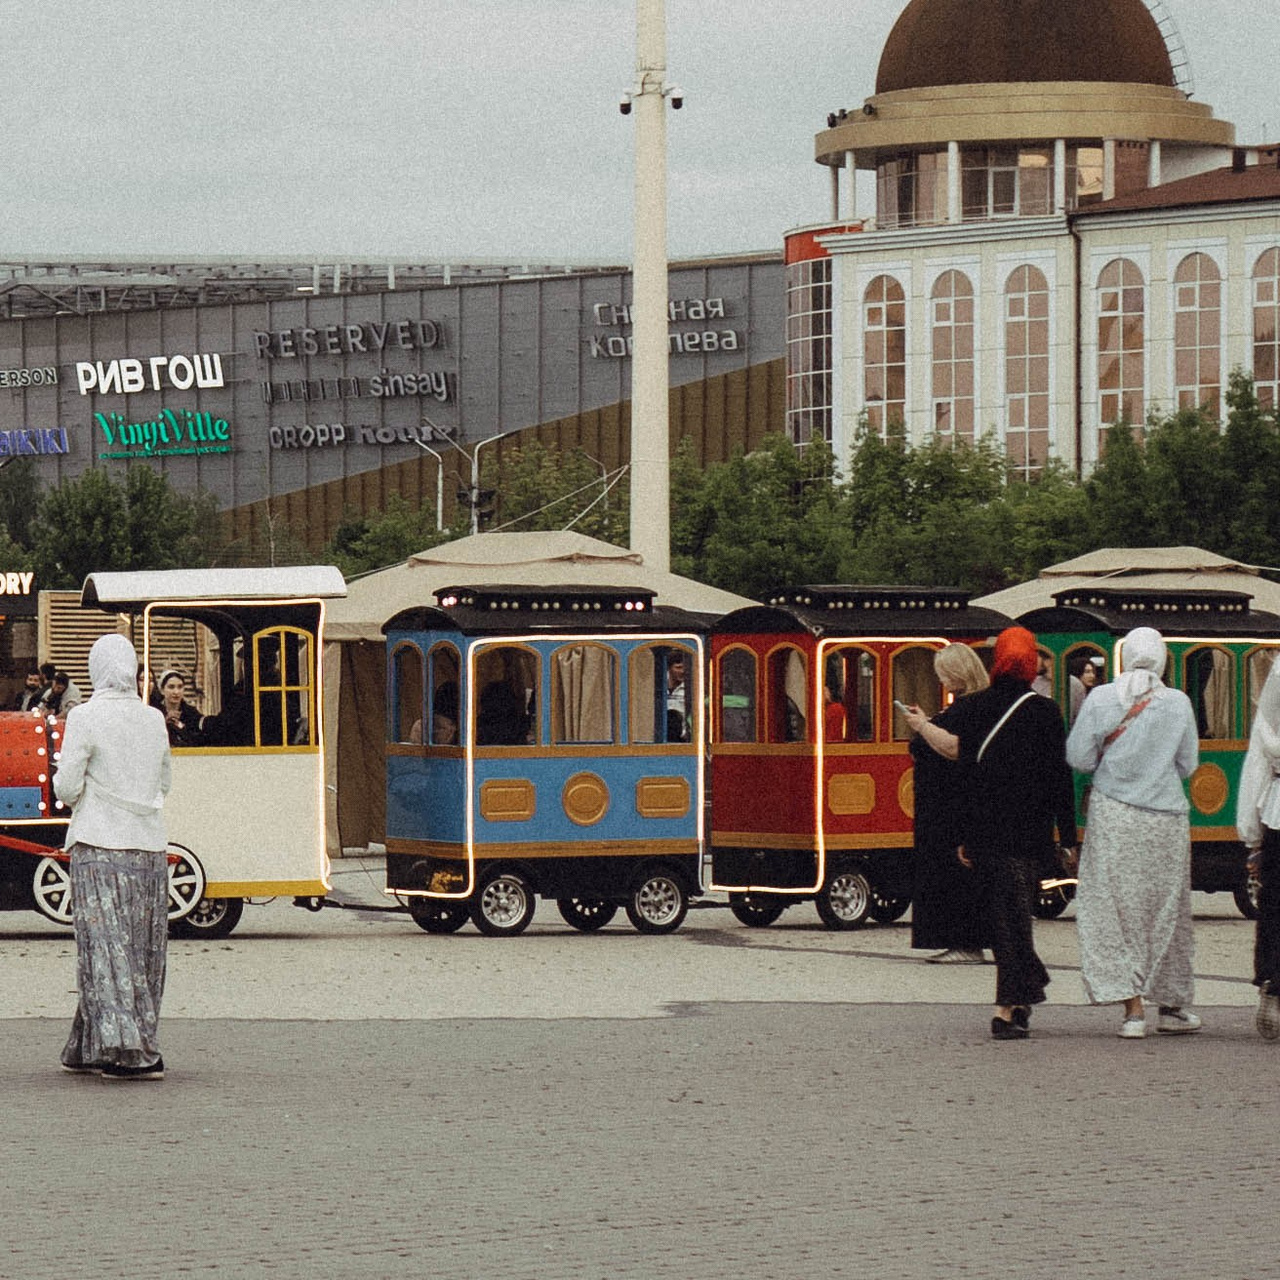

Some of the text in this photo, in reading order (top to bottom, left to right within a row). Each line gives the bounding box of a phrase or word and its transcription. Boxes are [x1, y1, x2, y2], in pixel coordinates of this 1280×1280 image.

[593, 297, 725, 326] Снная
[254, 320, 439, 358] RESERVED
[590, 329, 738, 358] Колева
[76, 352, 224, 395] РИВ ГОШ
[370, 369, 448, 402] sinsay
[270, 423, 346, 448] CROPP
